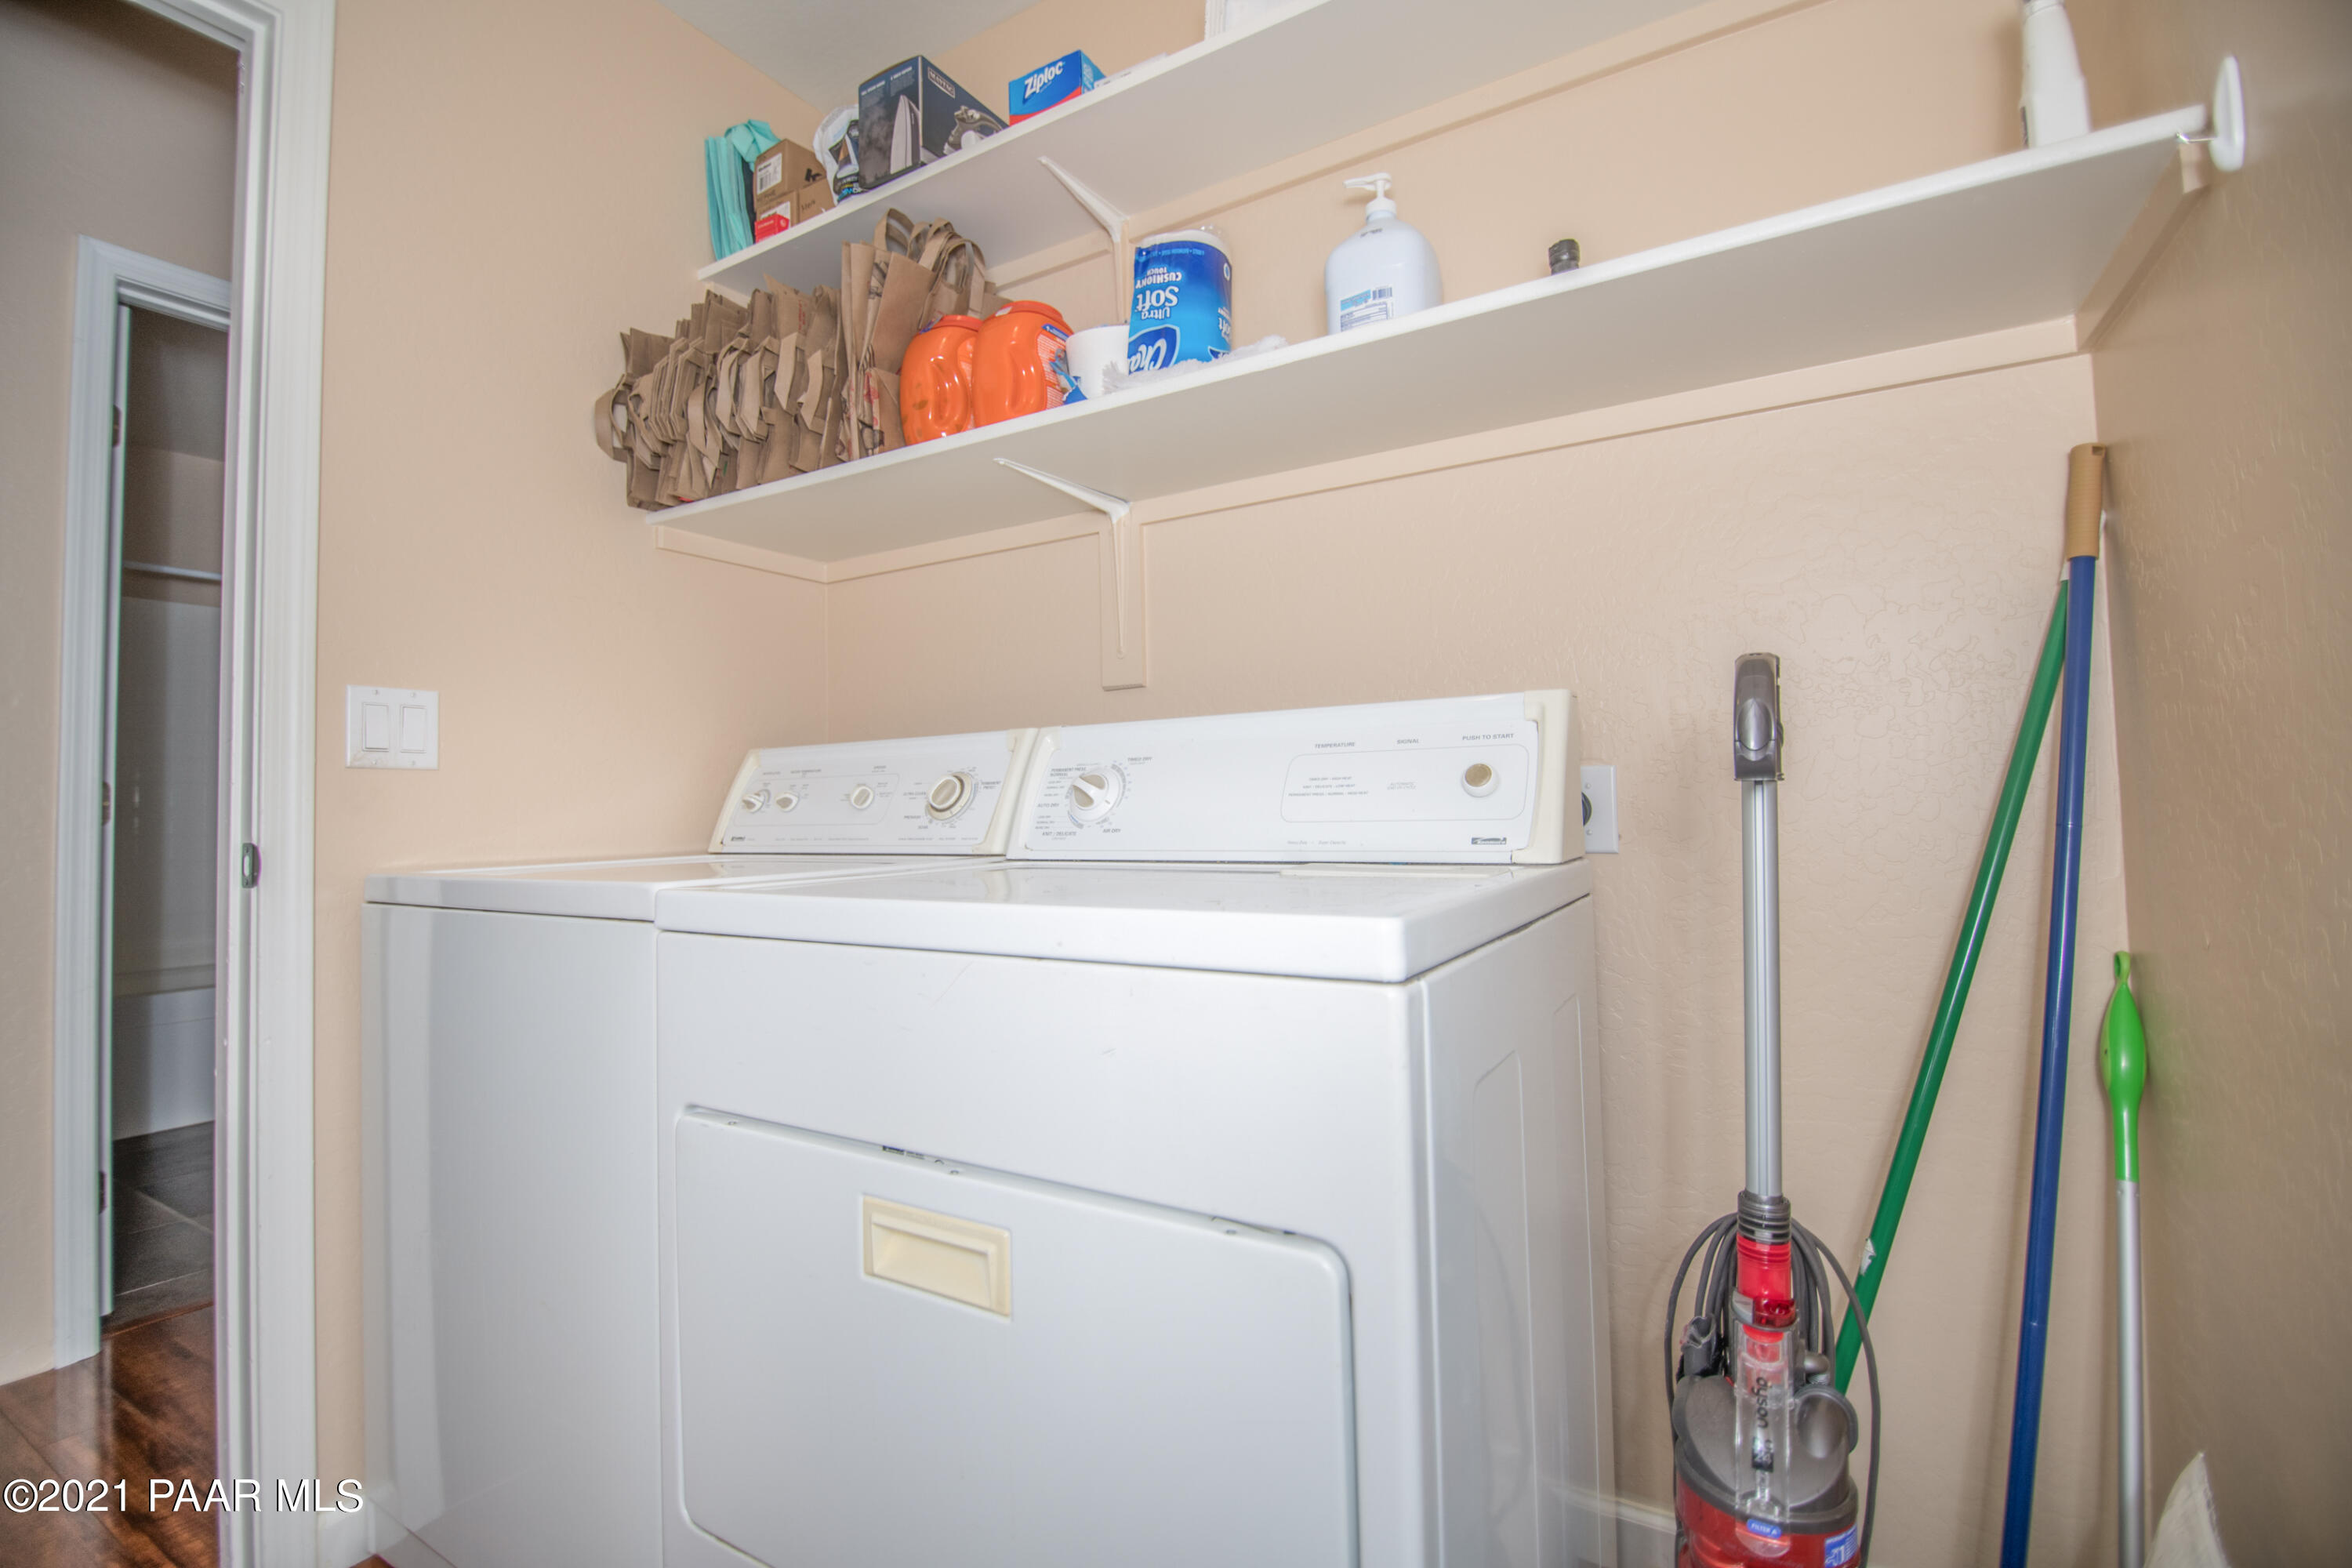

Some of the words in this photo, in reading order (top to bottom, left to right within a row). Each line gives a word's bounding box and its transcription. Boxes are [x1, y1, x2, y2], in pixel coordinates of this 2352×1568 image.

[1024, 61, 1064, 99] Ziploc
[1146, 267, 1167, 275] TOUCH
[1135, 272, 1182, 289] CUSHIONY
[1136, 285, 1179, 311] Soft
[1141, 307, 1171, 320] Ultra
[1314, 741, 1356, 750] TEMPERATURE
[1751, 1376, 1771, 1429] dyson
